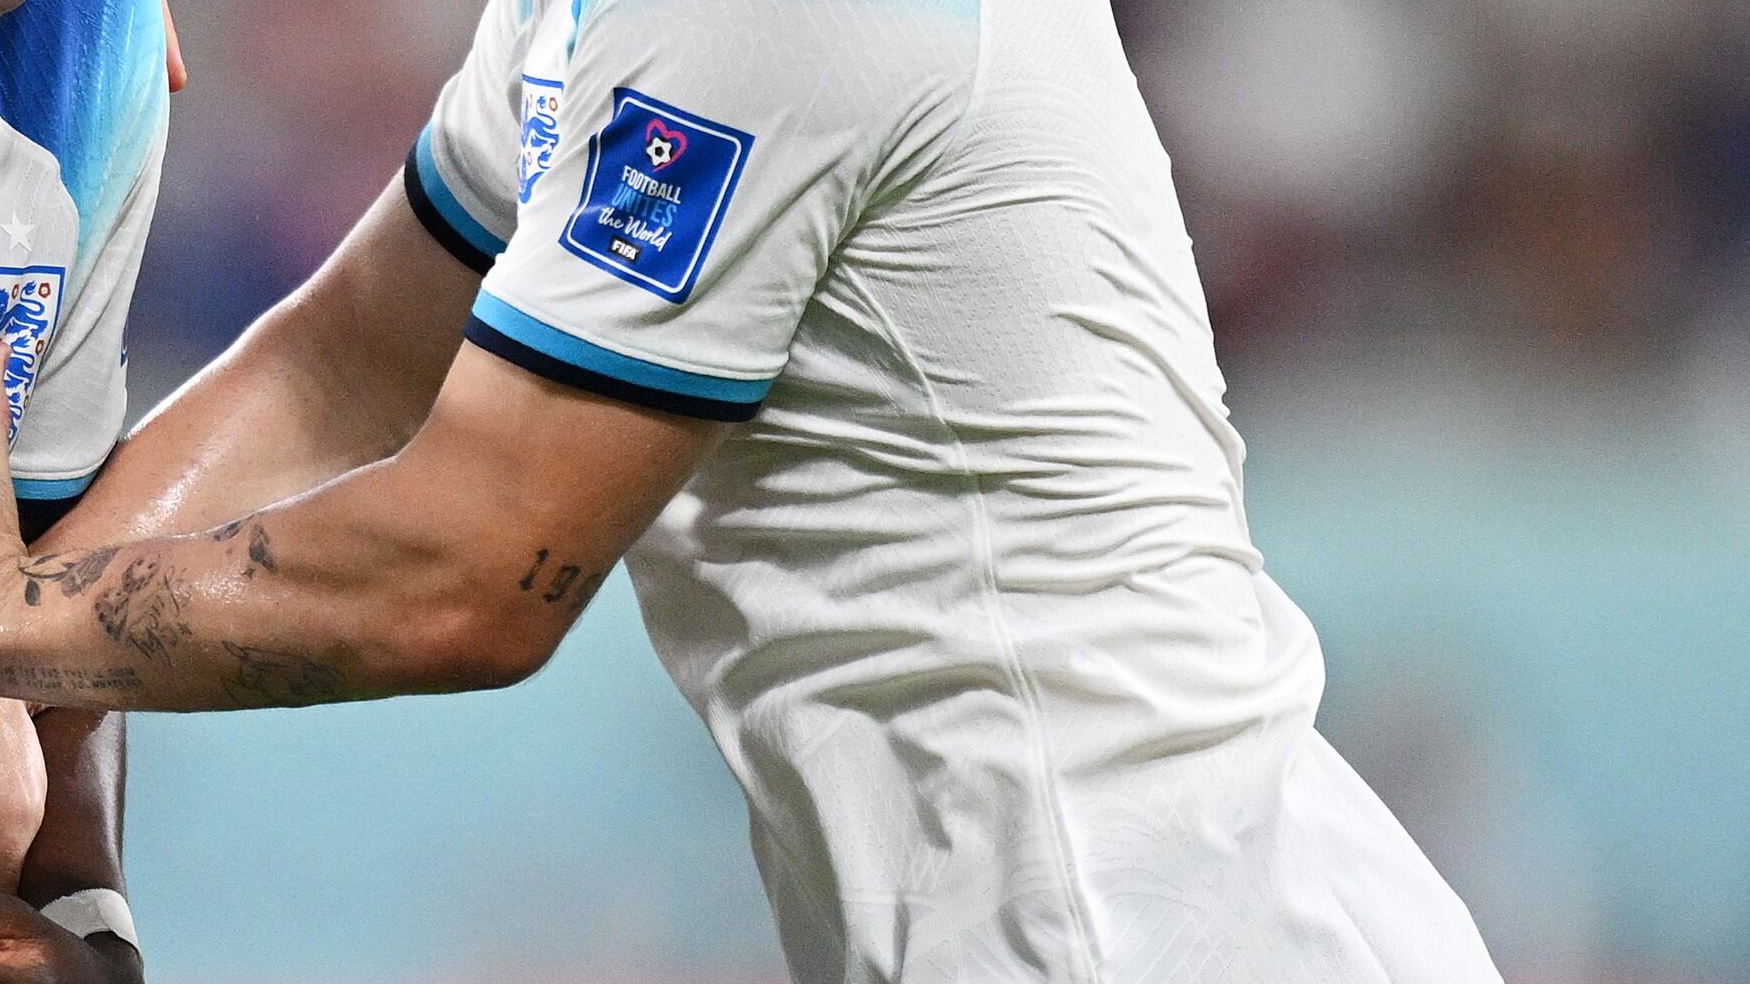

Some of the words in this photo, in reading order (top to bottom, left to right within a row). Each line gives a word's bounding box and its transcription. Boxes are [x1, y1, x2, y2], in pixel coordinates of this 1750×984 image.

[611, 182, 677, 227] UNITES
[621, 165, 682, 204] FOOTBALL
[598, 207, 623, 229] the
[623, 216, 672, 252] World
[611, 240, 639, 260] FIFA
